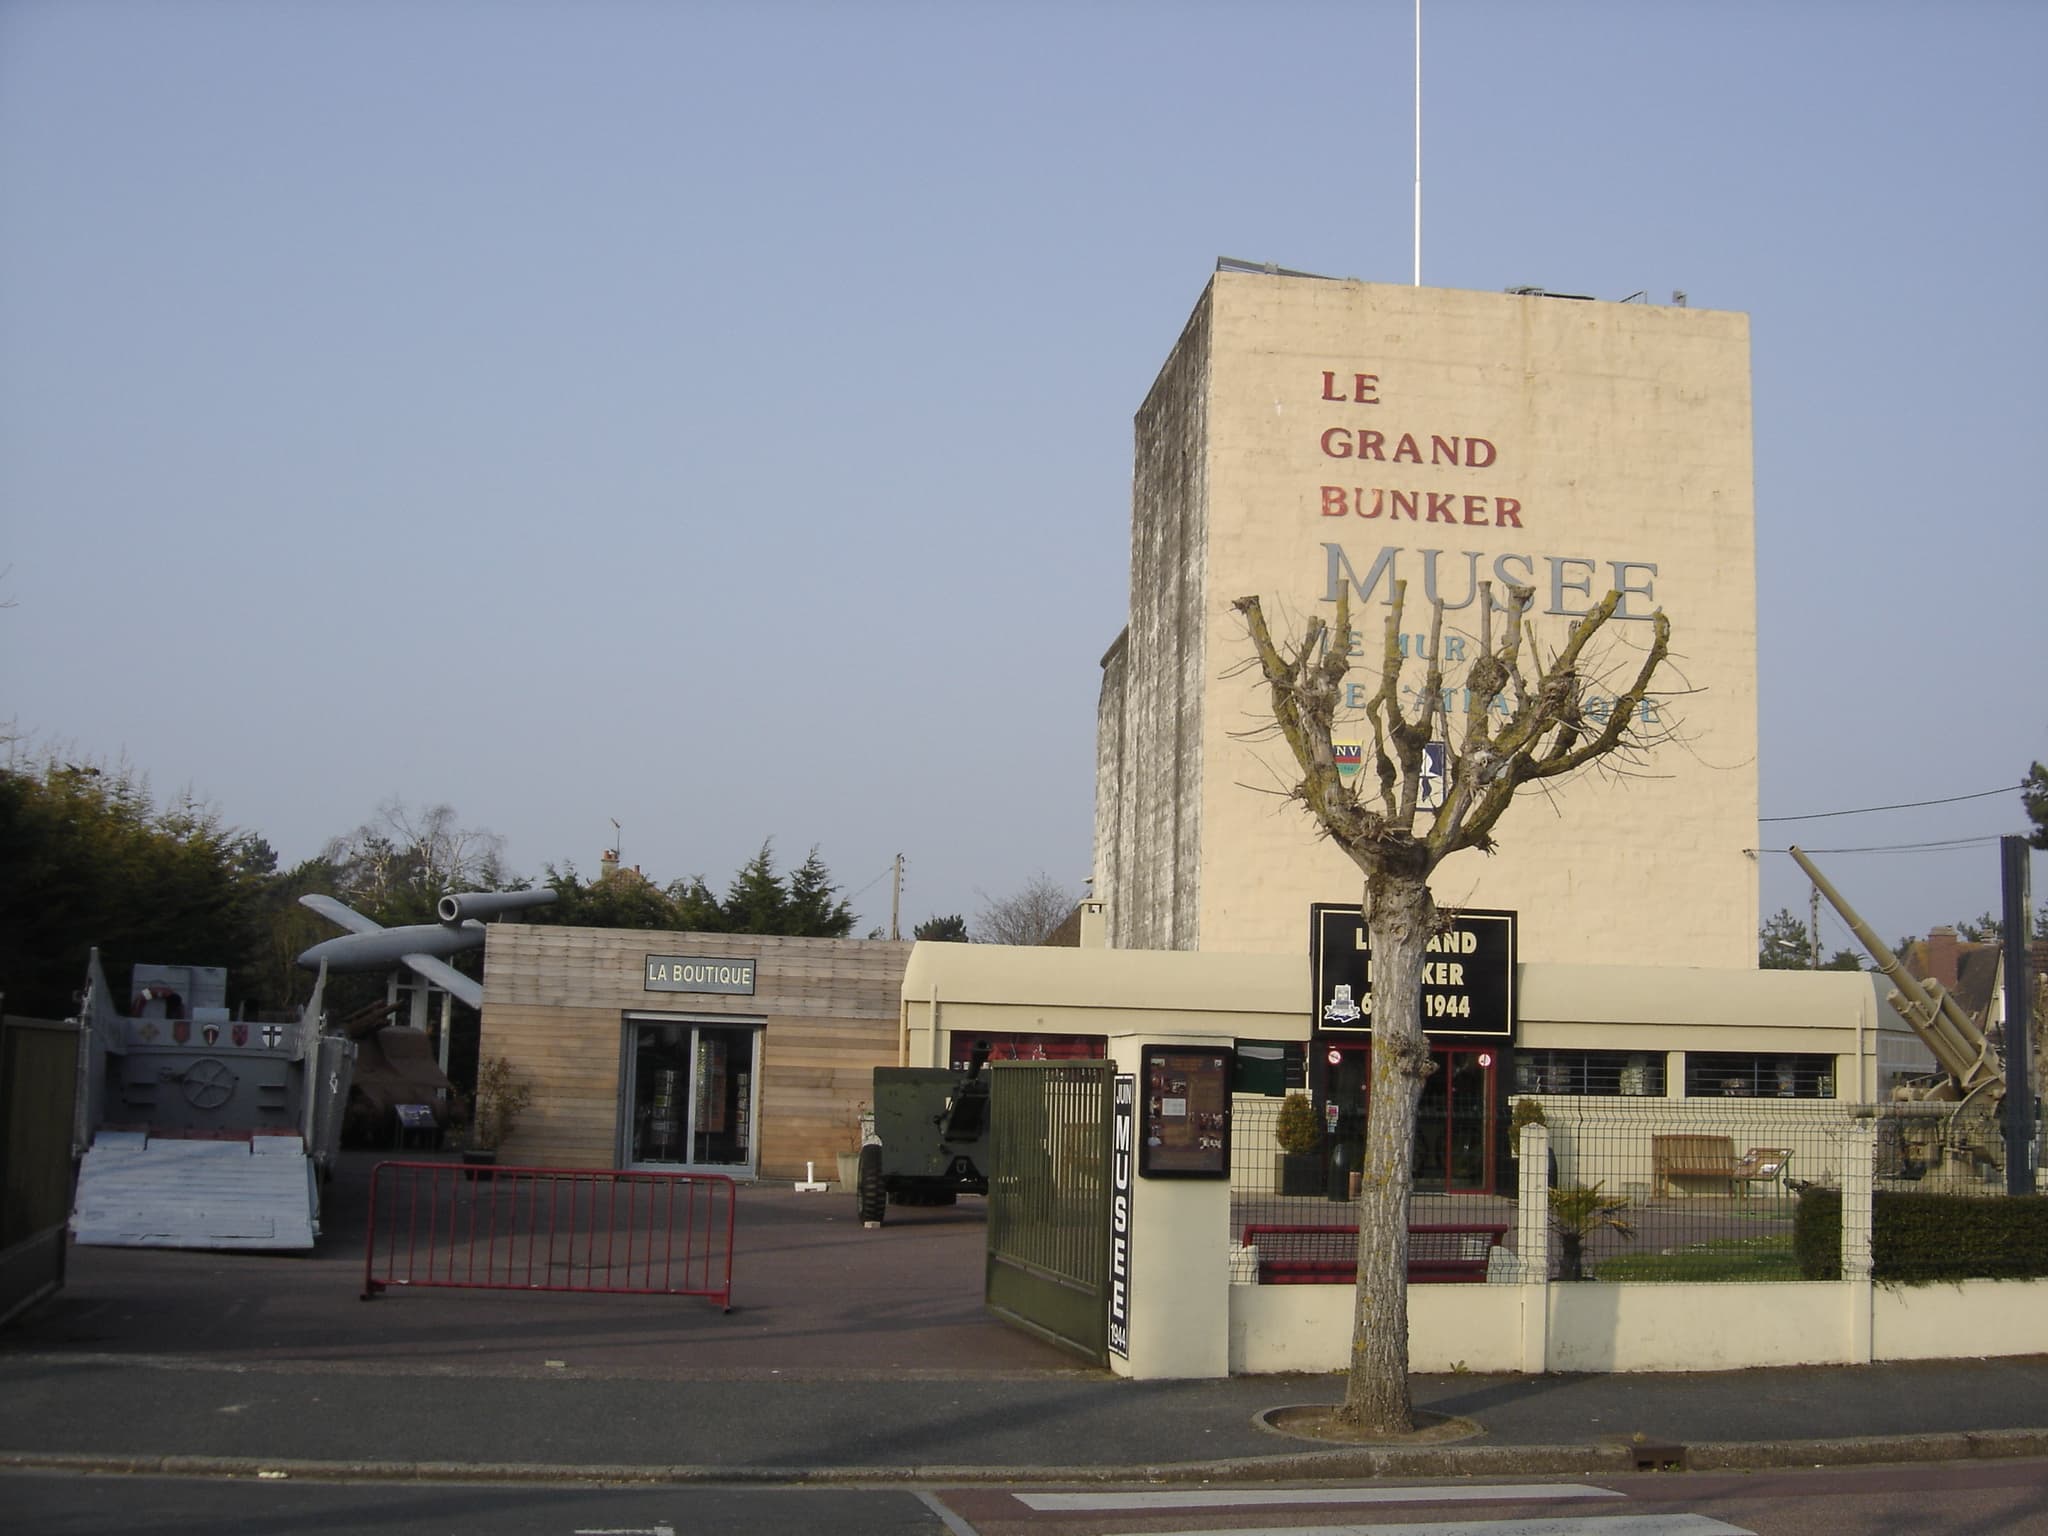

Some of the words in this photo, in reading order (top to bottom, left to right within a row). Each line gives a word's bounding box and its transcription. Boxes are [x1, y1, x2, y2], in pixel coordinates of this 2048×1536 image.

[1321, 371, 1380, 405] LE
[1320, 427, 1497, 468] GRAND
[1320, 485, 1524, 529] BUNKER
[1319, 542, 1663, 621] MUSEE
[1355, 927, 1372, 951] L
[649, 963, 668, 981] LA
[673, 964, 751, 985] BOUTIQUE
[1425, 994, 1471, 1018] 1944
[1112, 1114, 1131, 1320] MUSEE
[1110, 1321, 1126, 1349] 1944
